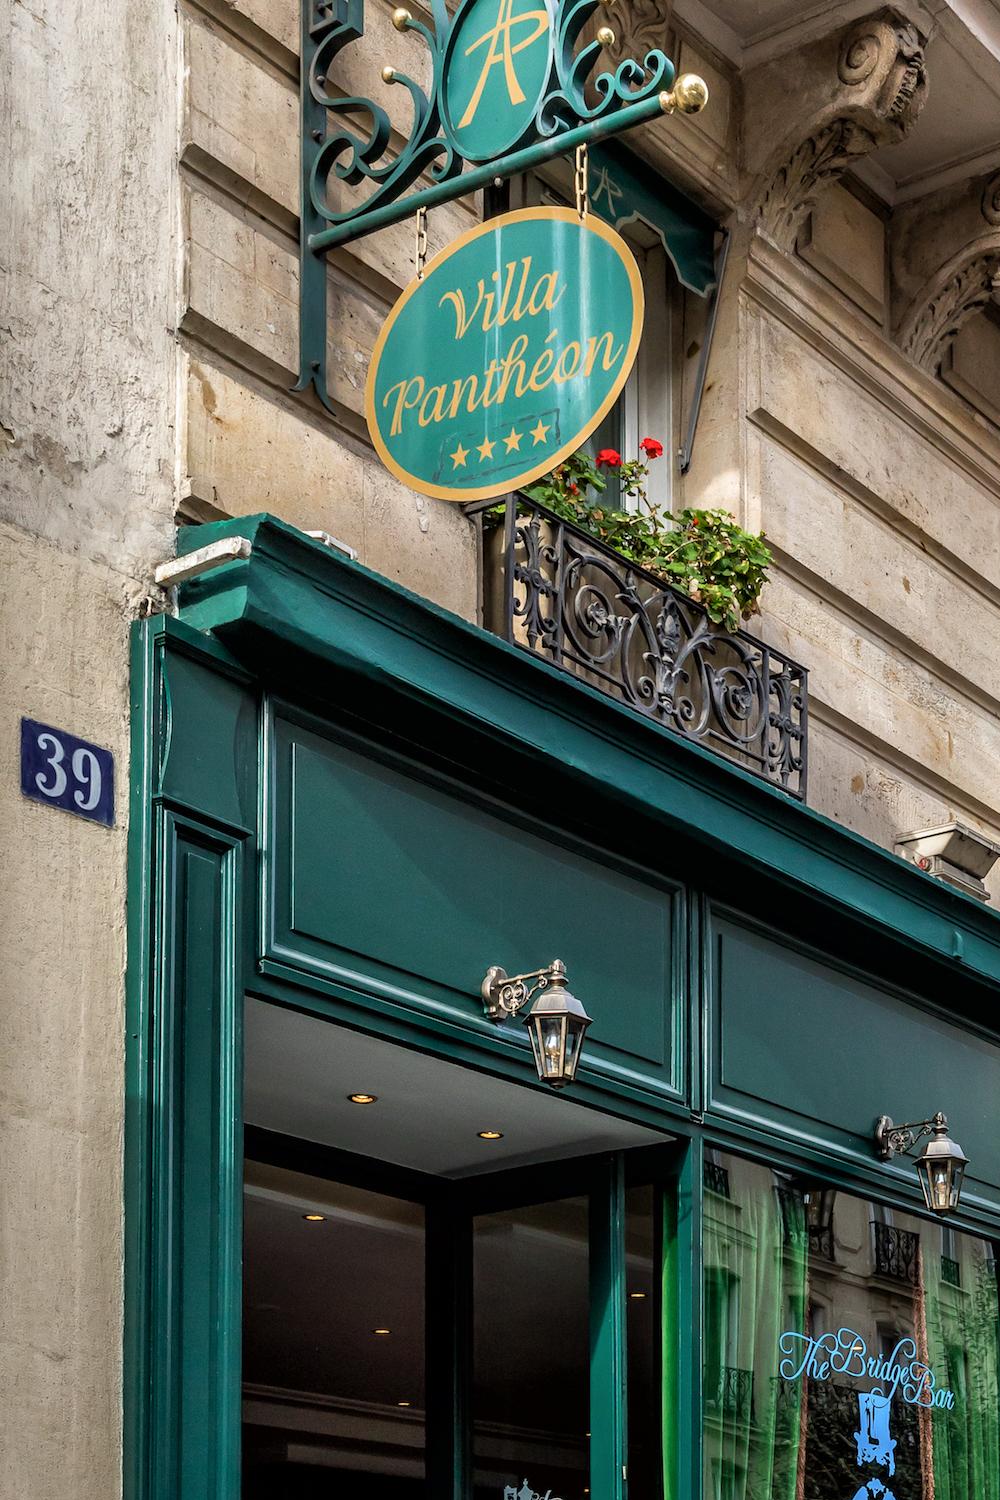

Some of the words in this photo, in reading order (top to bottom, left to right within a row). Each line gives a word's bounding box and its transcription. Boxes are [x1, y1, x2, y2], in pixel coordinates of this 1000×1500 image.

[438, 255, 568, 340] Villa
[383, 328, 625, 438] Panthéon
[35, 732, 102, 811] 39
[779, 1331, 839, 1380] The
[830, 1327, 917, 1408] Bridge
[902, 1361, 955, 1410] Bar
